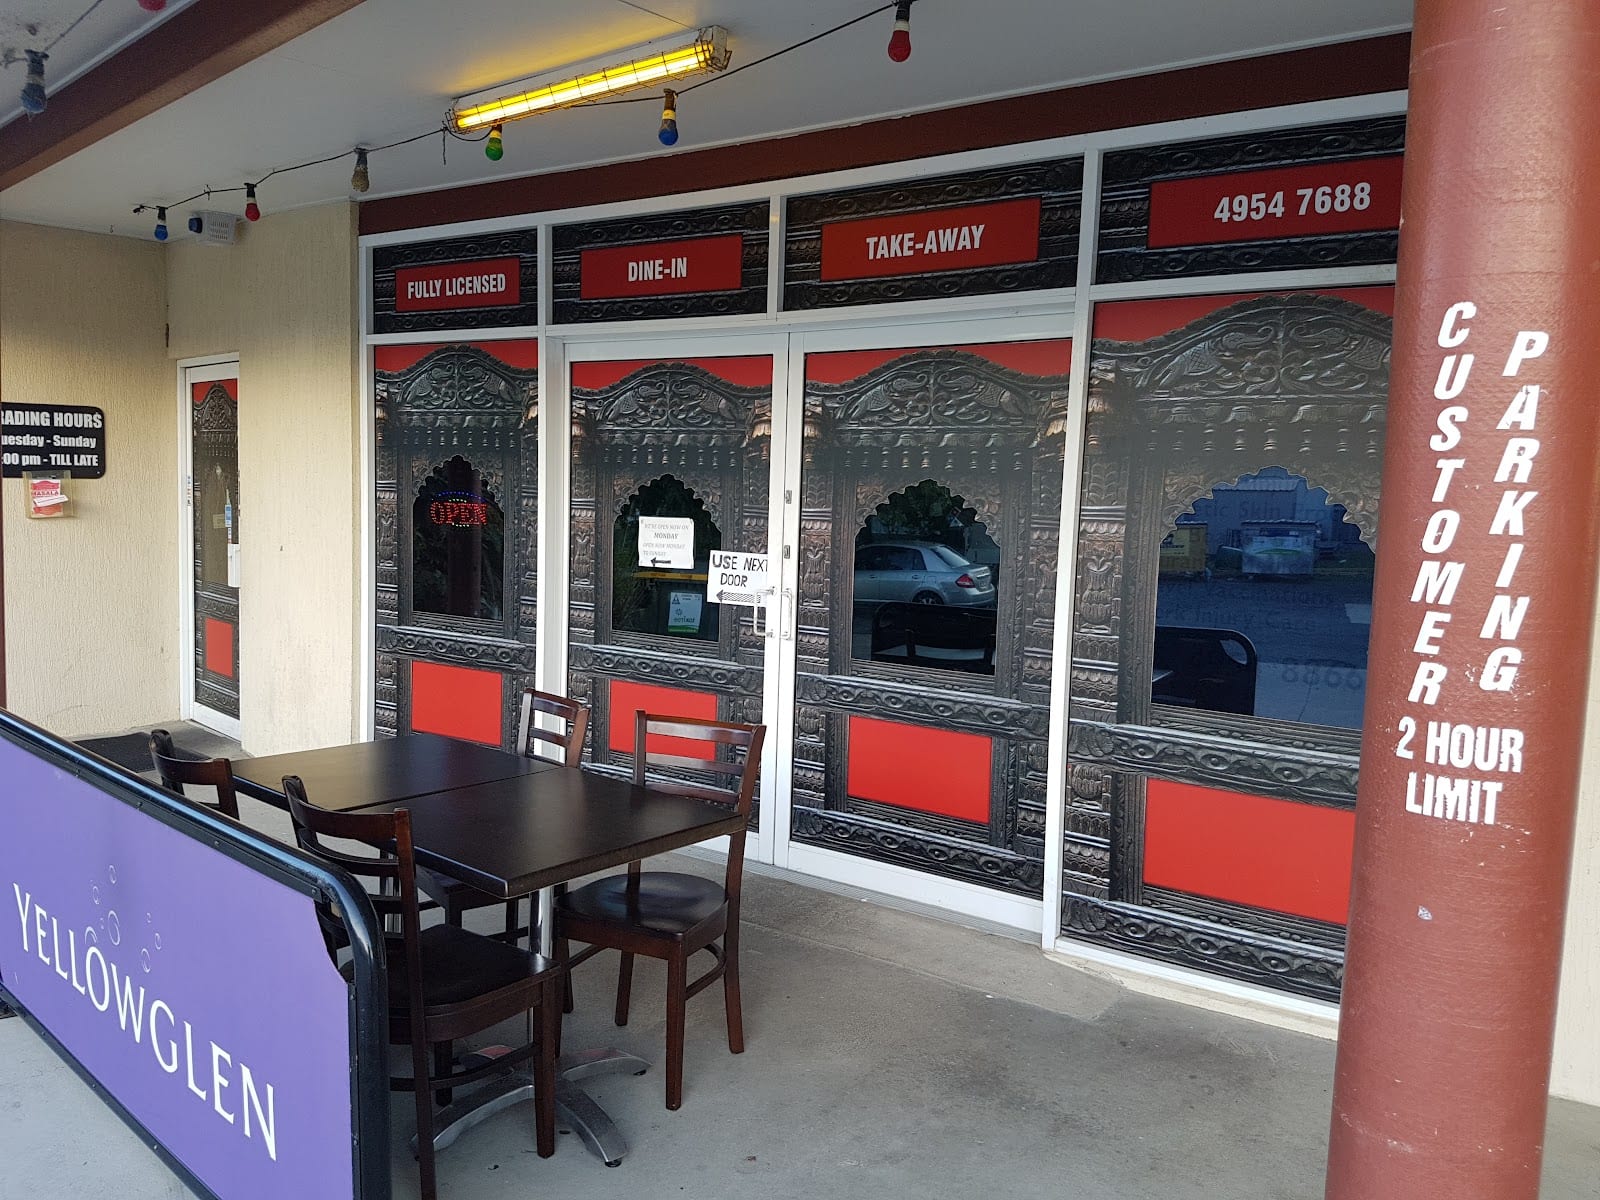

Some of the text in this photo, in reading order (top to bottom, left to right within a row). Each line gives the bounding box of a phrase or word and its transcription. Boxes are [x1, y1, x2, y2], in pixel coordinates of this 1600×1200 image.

[1213, 182, 1372, 223] 4954 7688
[865, 224, 986, 261] TAKE-AWAY
[628, 257, 688, 282] DINE-IN
[407, 272, 507, 299] FULLY LICENSED
[53, 411, 103, 429] HOURS
[1, 434, 45, 448] uesday
[53, 435, 97, 449] Sunday
[21, 454, 41, 466] pm
[49, 453, 73, 466] TILL
[73, 454, 99, 467] LATE
[428, 501, 488, 526] OPEN
[1407, 301, 1477, 706] CUSTOMER
[1478, 330, 1549, 692] PARKING
[653, 532, 679, 540] MONDAY
[712, 553, 738, 570] USE
[720, 572, 748, 587] DOOR
[1395, 716, 1524, 774] 2 HOUR
[1405, 771, 1503, 825] LIMIT
[12, 882, 277, 1162] YELLOWGLEN
